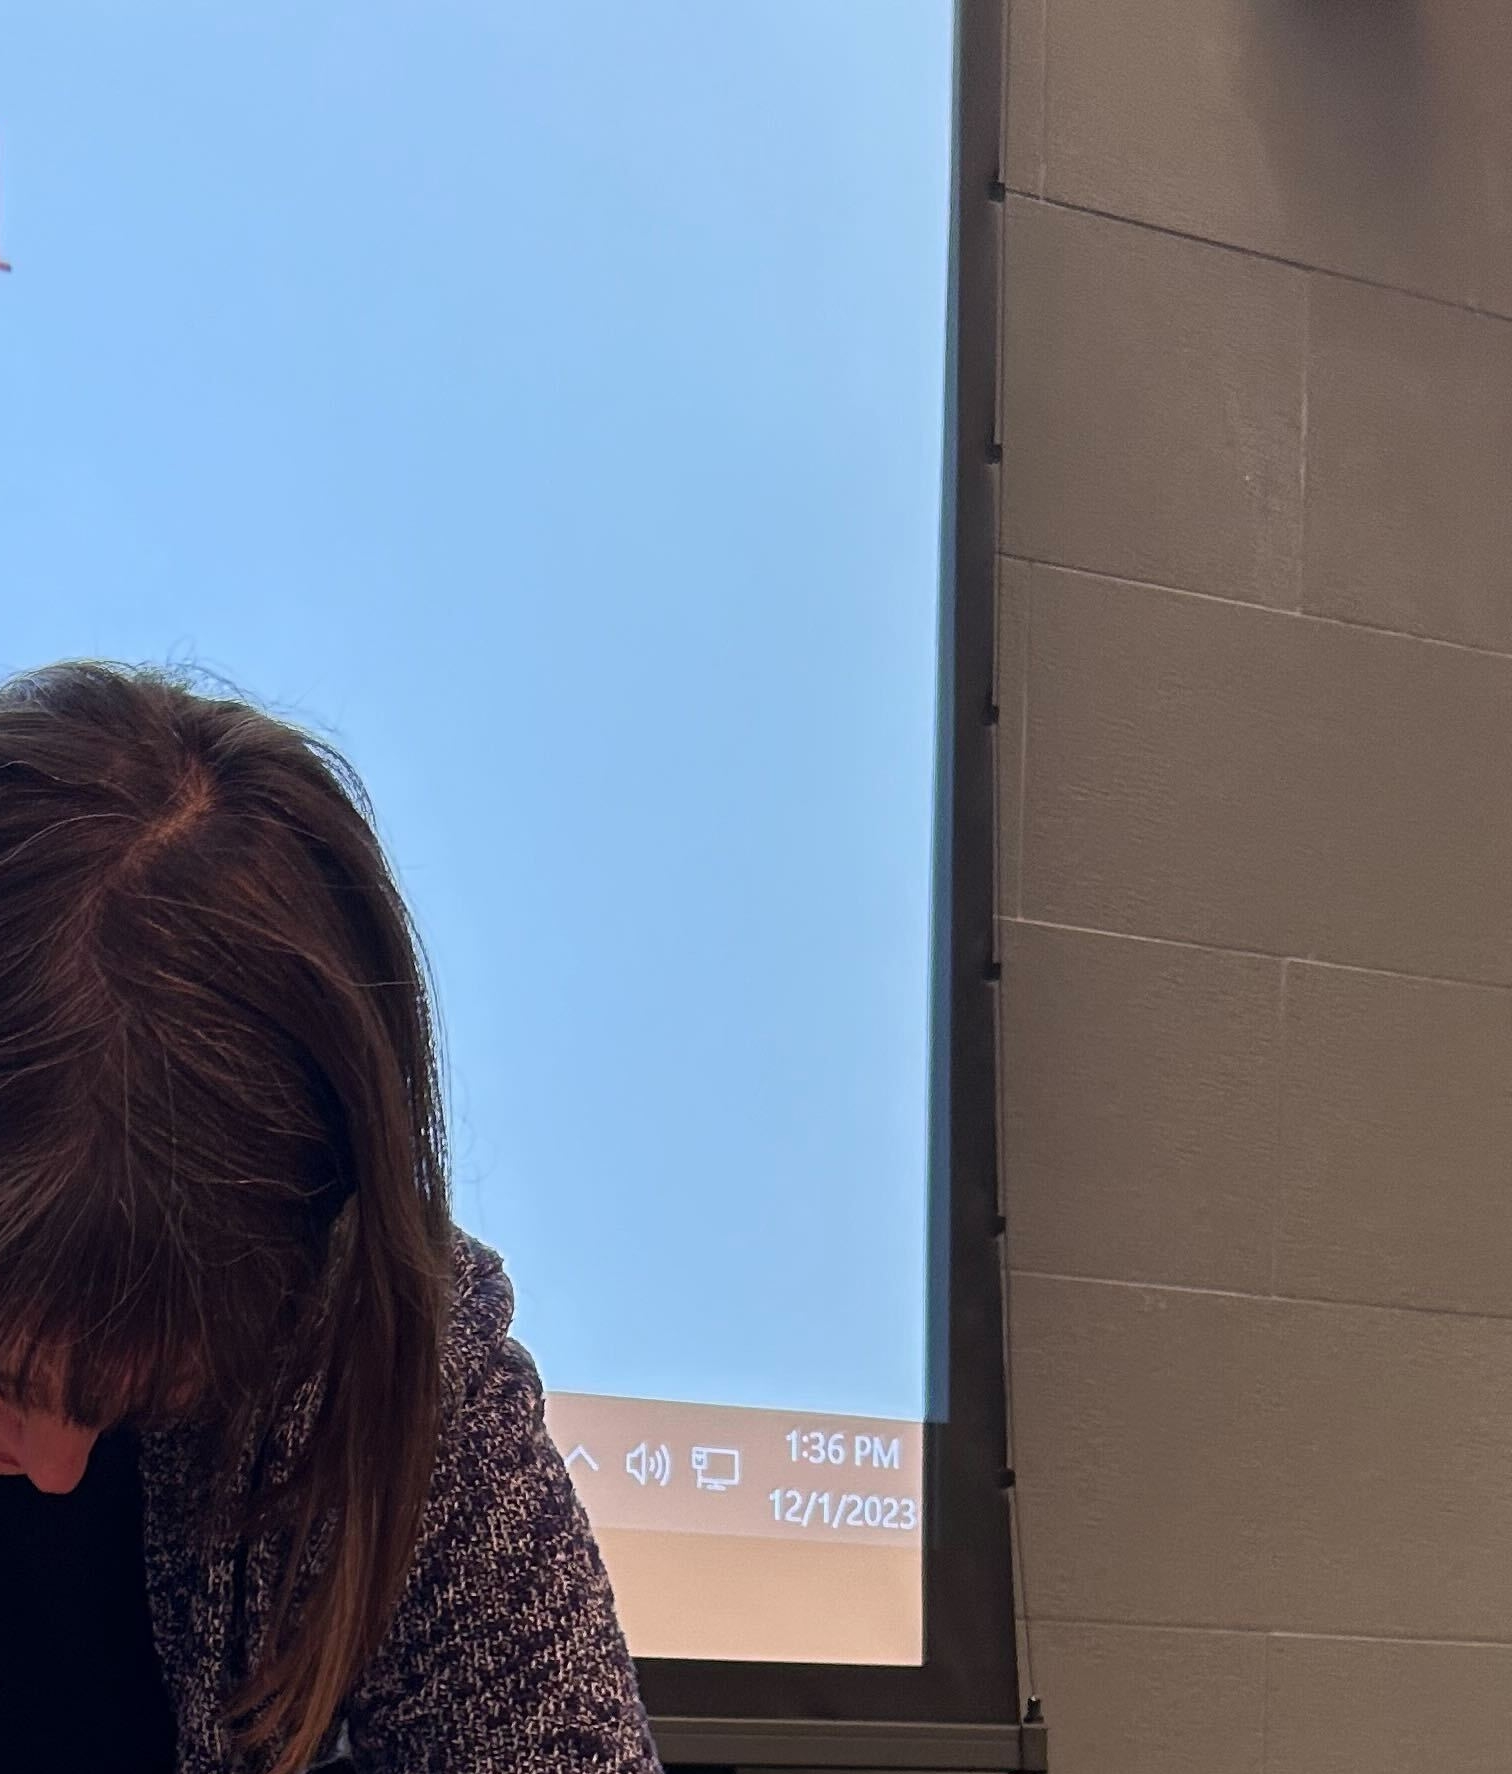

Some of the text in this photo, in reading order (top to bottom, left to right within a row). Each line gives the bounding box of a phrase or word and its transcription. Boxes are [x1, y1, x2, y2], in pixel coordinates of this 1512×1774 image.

[785, 1428, 901, 1470] 1:36 PM
[769, 1489, 918, 1530] 12/1/2023
